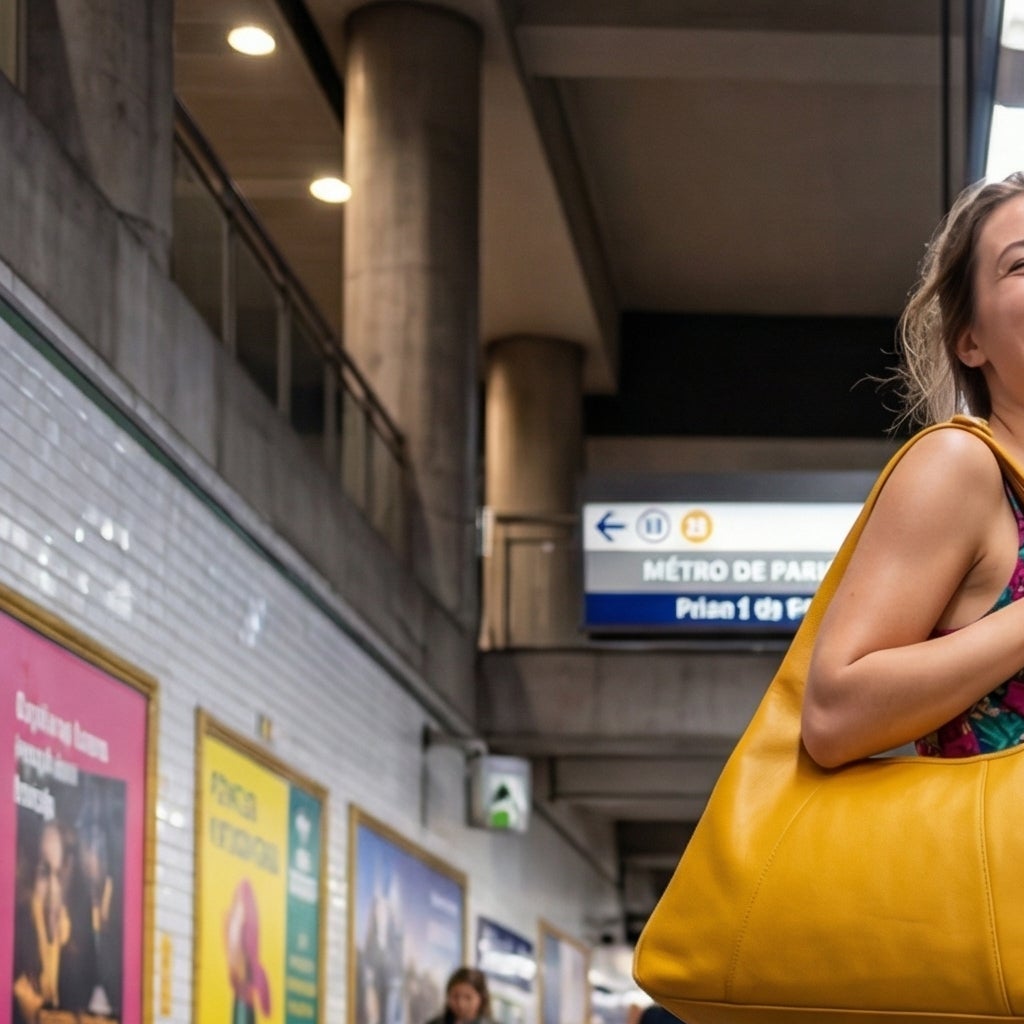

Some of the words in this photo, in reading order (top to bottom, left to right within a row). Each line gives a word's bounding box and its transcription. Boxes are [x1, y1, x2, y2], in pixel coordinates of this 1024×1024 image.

[643, 555, 729, 582] MÉTRO
[733, 560, 768, 582] DE
[771, 560, 834, 582] PARI
